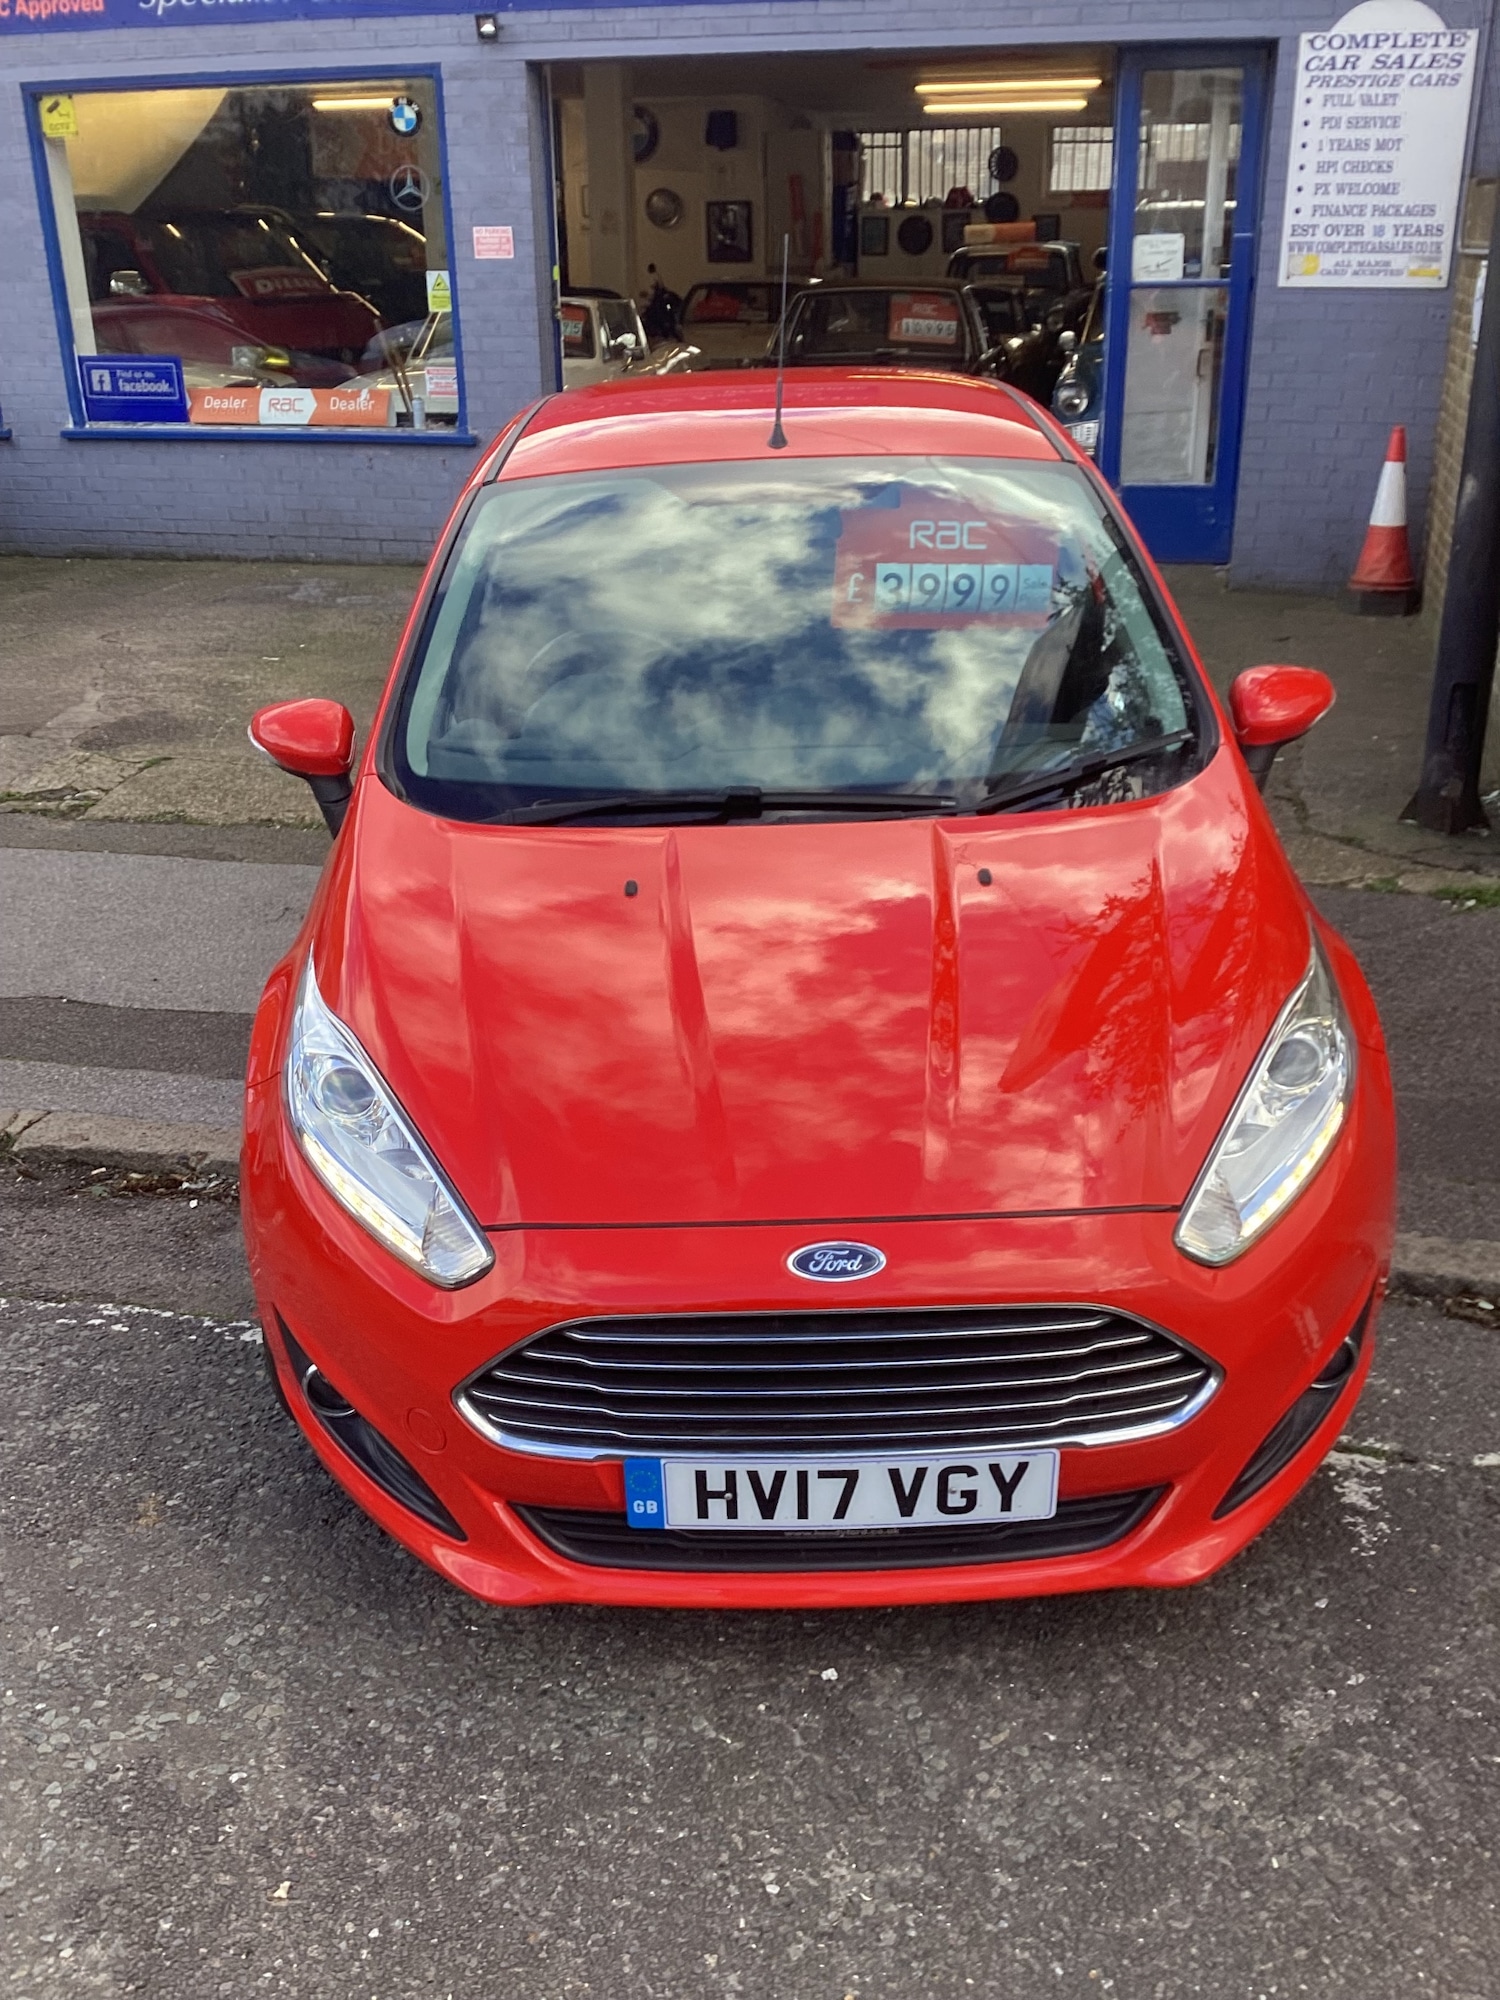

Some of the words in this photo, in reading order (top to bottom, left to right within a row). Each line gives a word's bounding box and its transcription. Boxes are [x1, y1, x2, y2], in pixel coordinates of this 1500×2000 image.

[15, 0, 104, 20] Approved
[1308, 31, 1469, 50] COMPLETE
[1304, 54, 1361, 72] CAR
[1371, 52, 1466, 70] SALES
[1305, 74, 1404, 89] PRESTIGE
[1409, 72, 1463, 88] CARS
[1321, 93, 1355, 107] FULL
[1359, 92, 1400, 107] VALET
[1320, 116, 1344, 130] PDI
[1346, 115, 1401, 130] SERVICE
[1318, 139, 1324, 152] 1
[1328, 138, 1372, 151] YEARS
[1374, 137, 1403, 151] MOT
[1316, 160, 1339, 174] HPI
[1342, 160, 1394, 174] CHECKS
[1313, 182, 1333, 196] PX
[1336, 182, 1400, 196] WELCOME
[1311, 204, 1367, 217] FINANCE
[1370, 203, 1437, 217] PACKAGES
[1290, 224, 1321, 237] EST
[1324, 224, 1366, 237] OVER
[1392, 223, 1445, 237] YEARS
[203, 395, 248, 409] Dealer
[329, 396, 375, 411] Dealer
[808, 1250, 863, 1273] Ford
[694, 1469, 860, 1520] HV17
[887, 1461, 1030, 1518] VGY
[632, 1500, 659, 1515] GB
